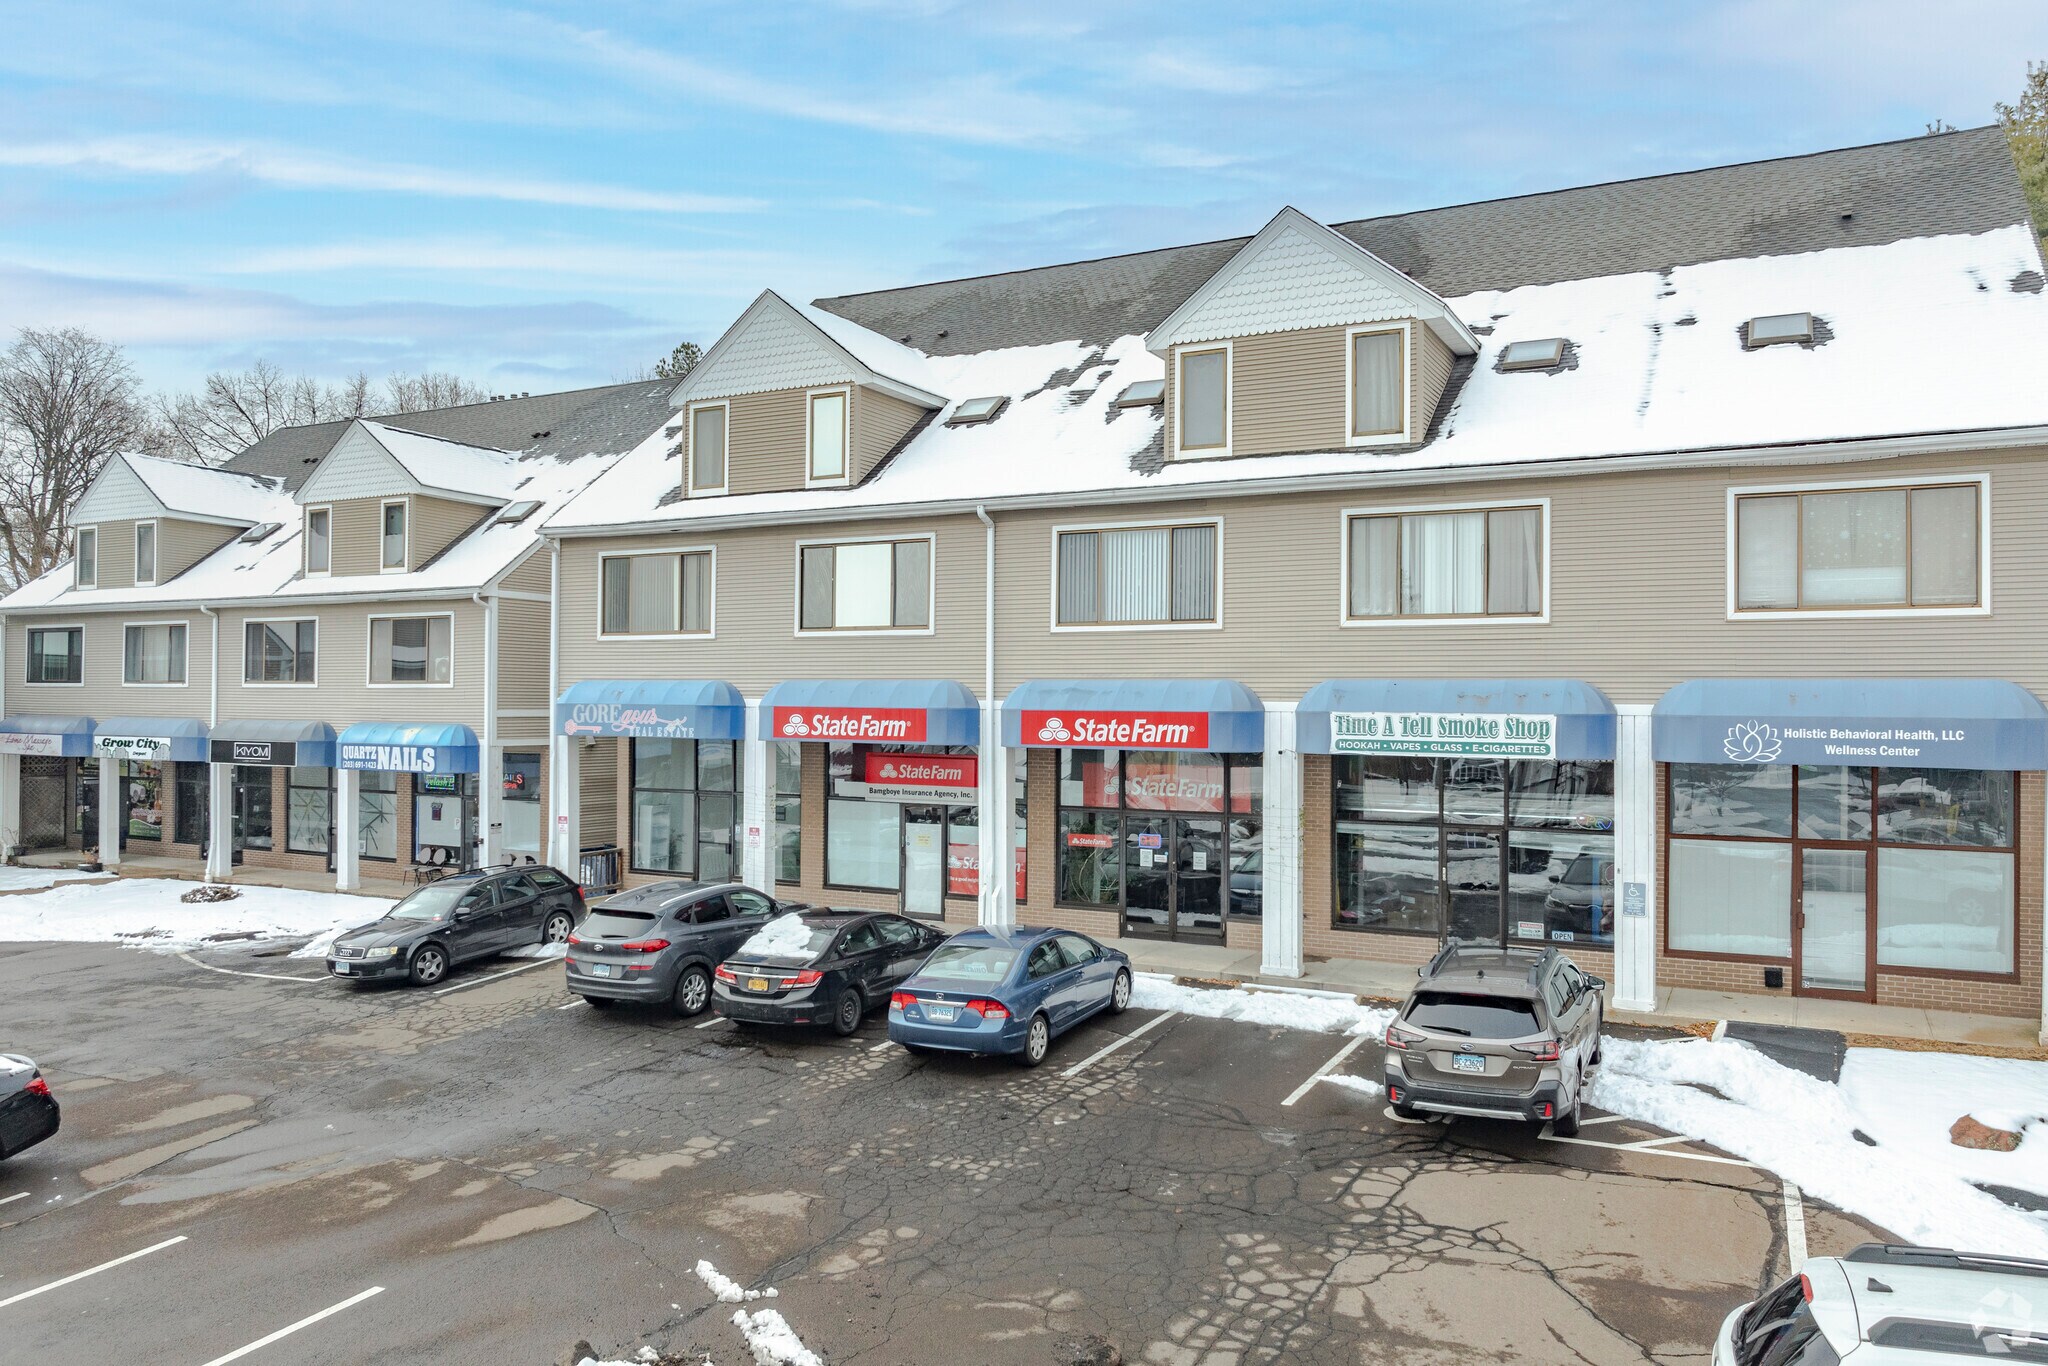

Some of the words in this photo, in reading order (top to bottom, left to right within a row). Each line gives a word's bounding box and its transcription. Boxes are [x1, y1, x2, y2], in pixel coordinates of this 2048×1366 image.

[1335, 715, 1379, 736] Time
[1382, 716, 1395, 737] A
[1399, 716, 1432, 737] Tell
[1438, 717, 1499, 739] Smoke
[1504, 717, 1551, 742] Shop
[1784, 728, 1827, 739] Holistic
[1829, 728, 1892, 740] Behavioral
[1894, 730, 1939, 742] Health,
[1942, 730, 1965, 741] LLC
[102, 737, 133, 748] Grow
[136, 738, 160, 750] City
[1339, 741, 1380, 750] HOOKAH
[1390, 742, 1421, 751] VAPES
[1430, 743, 1462, 752] GLASS
[1472, 744, 1546, 754] E-CIGARETTES
[342, 745, 377, 760] QUARTZ
[1825, 744, 1877, 756] Wellness
[1879, 745, 1920, 757] Center
[377, 746, 436, 773] NAILS
[869, 787, 900, 797] Bamgboye
[901, 788, 933, 798] Insurance
[934, 790, 959, 800] Agency,
[960, 791, 973, 799] Inc.
[1553, 932, 1572, 940] OPEN
